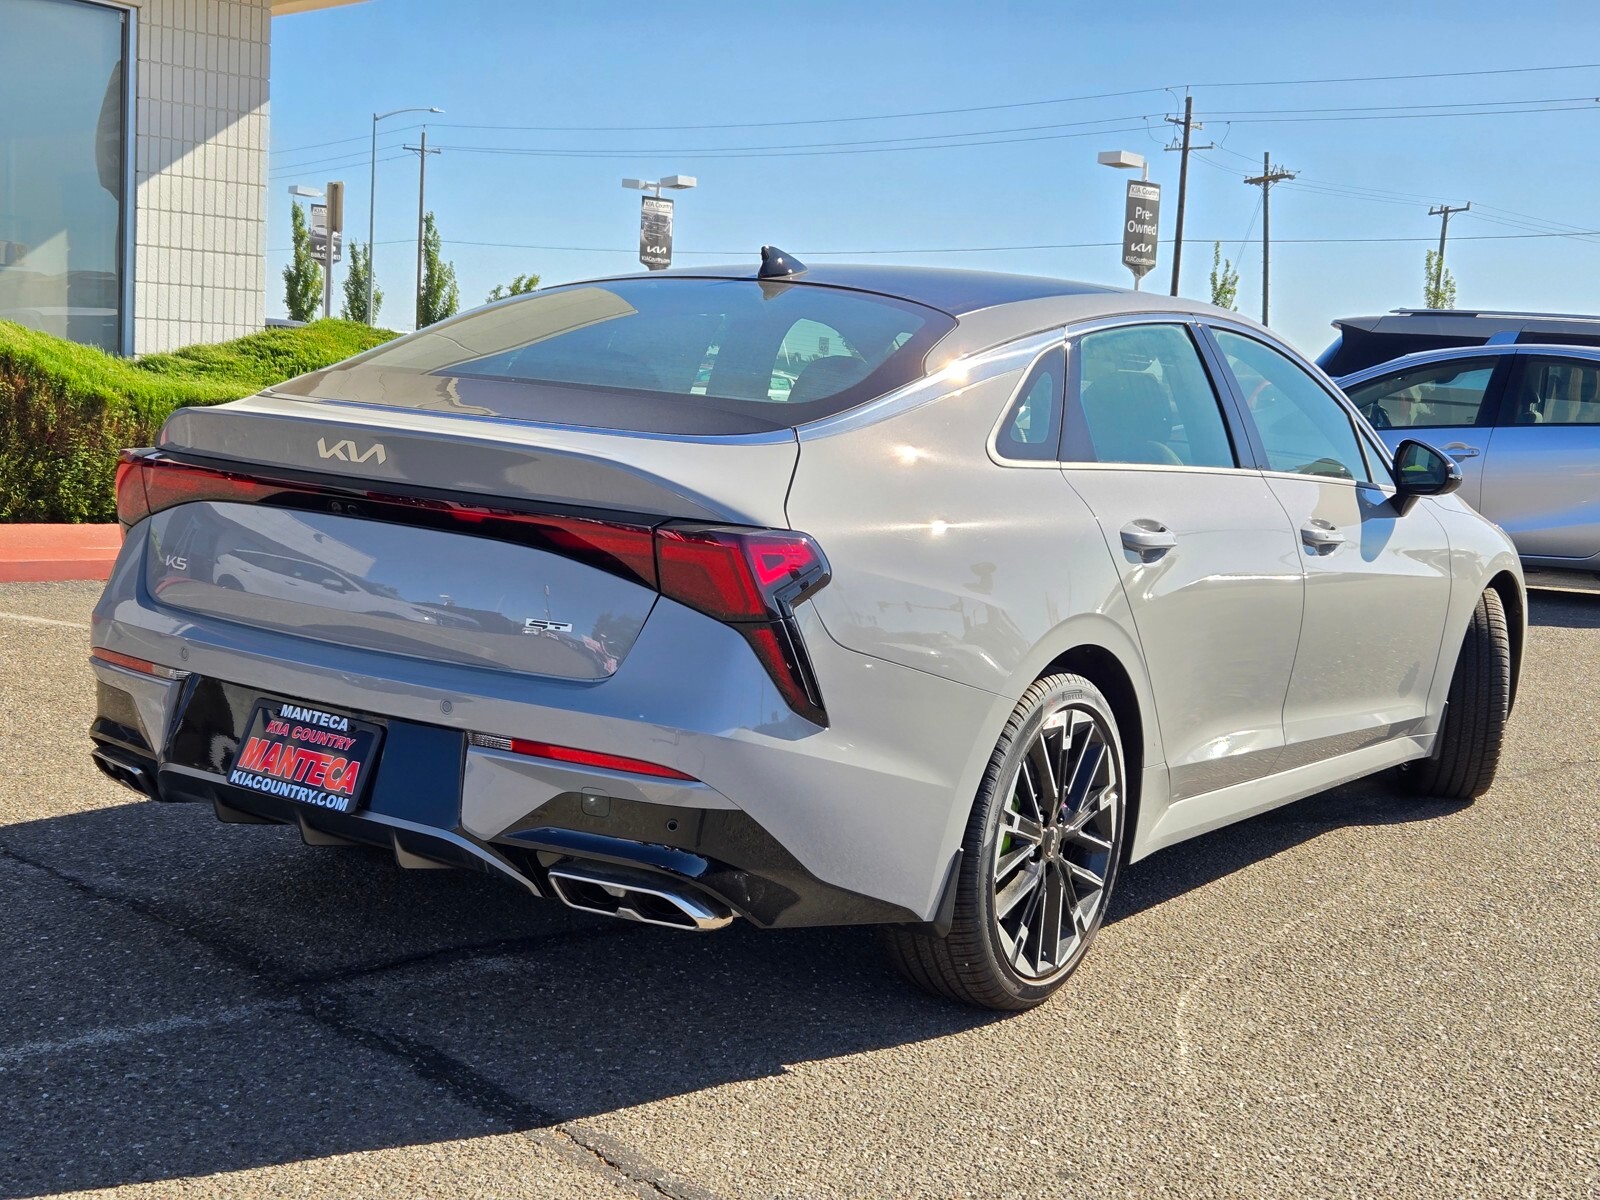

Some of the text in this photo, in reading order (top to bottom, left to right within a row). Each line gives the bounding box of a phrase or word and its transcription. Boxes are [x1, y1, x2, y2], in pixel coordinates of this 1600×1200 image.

[1131, 185, 1158, 197] KIA Country
[1135, 206, 1153, 220] Pre-
[1127, 220, 1157, 235] Owned
[317, 437, 387, 465] KIA
[165, 554, 188, 570] K5
[280, 703, 349, 731] MANTECA
[266, 719, 357, 751] KIA COUNTRY
[237, 736, 361, 795] MANTECA
[230, 769, 349, 812] KIACOUNTRY.COM
